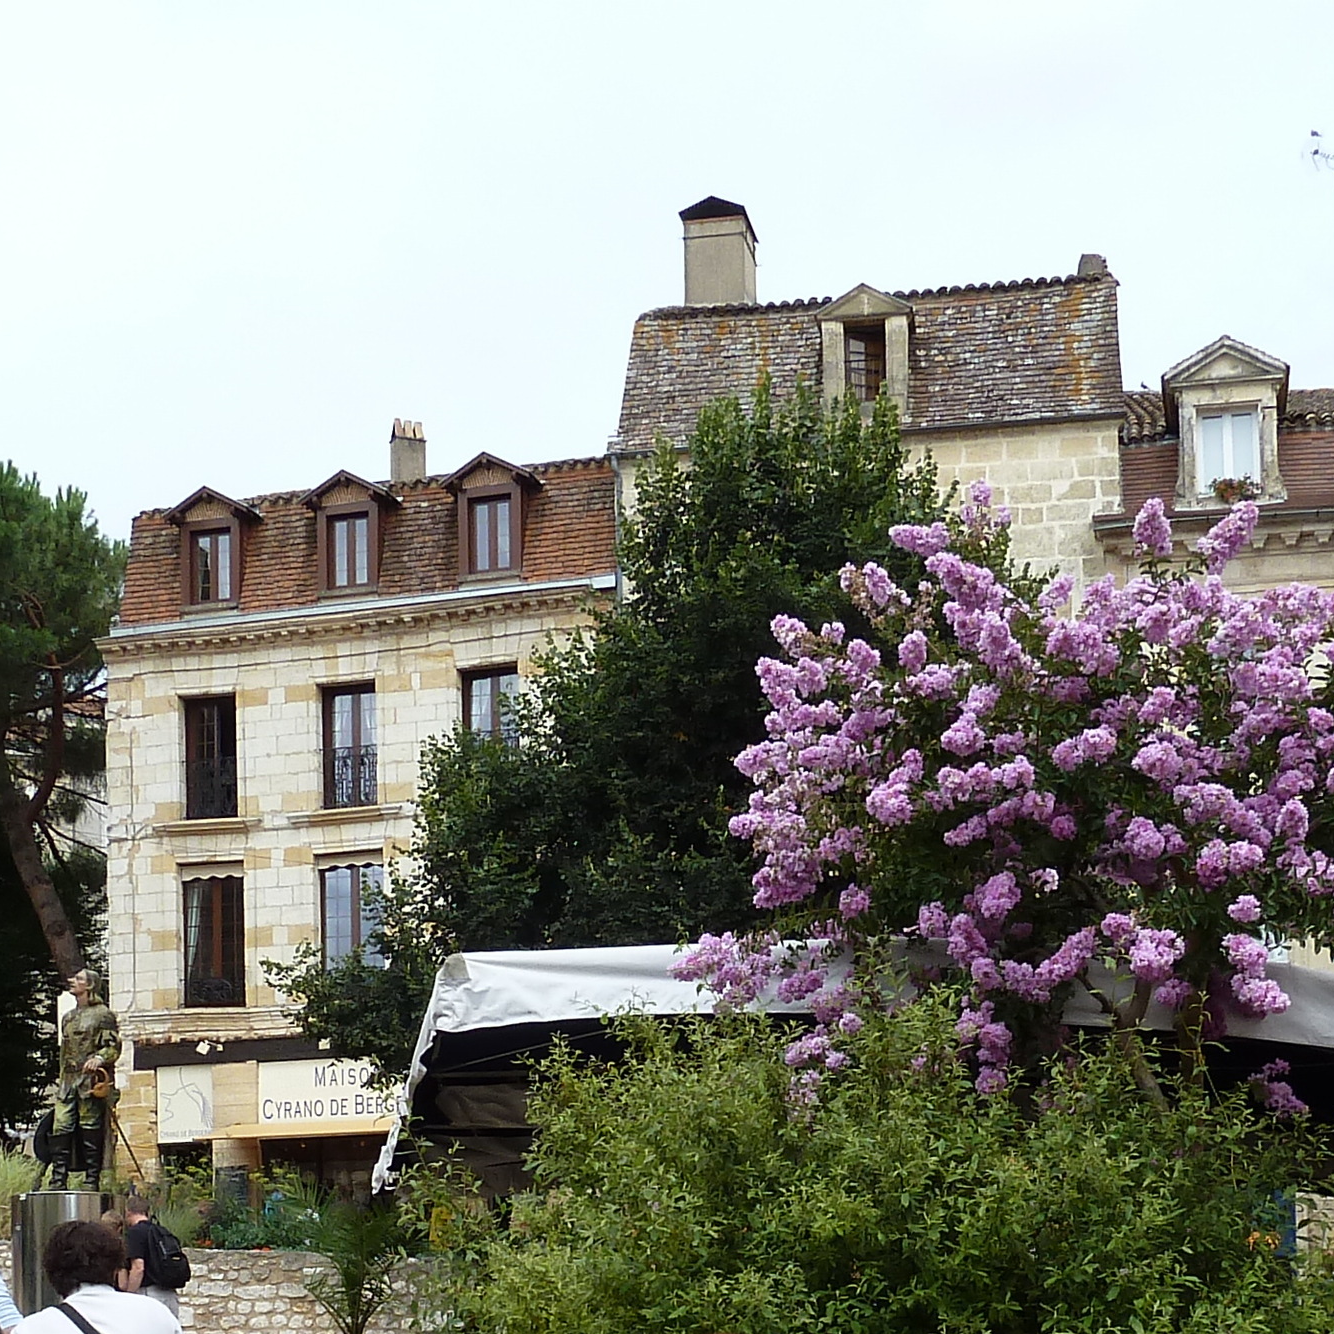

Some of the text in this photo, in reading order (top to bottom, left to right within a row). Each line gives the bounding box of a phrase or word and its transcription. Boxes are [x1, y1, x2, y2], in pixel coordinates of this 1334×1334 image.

[314, 1066, 371, 1089] MAISO
[262, 1094, 403, 1120] CYRANO DE BERGE
